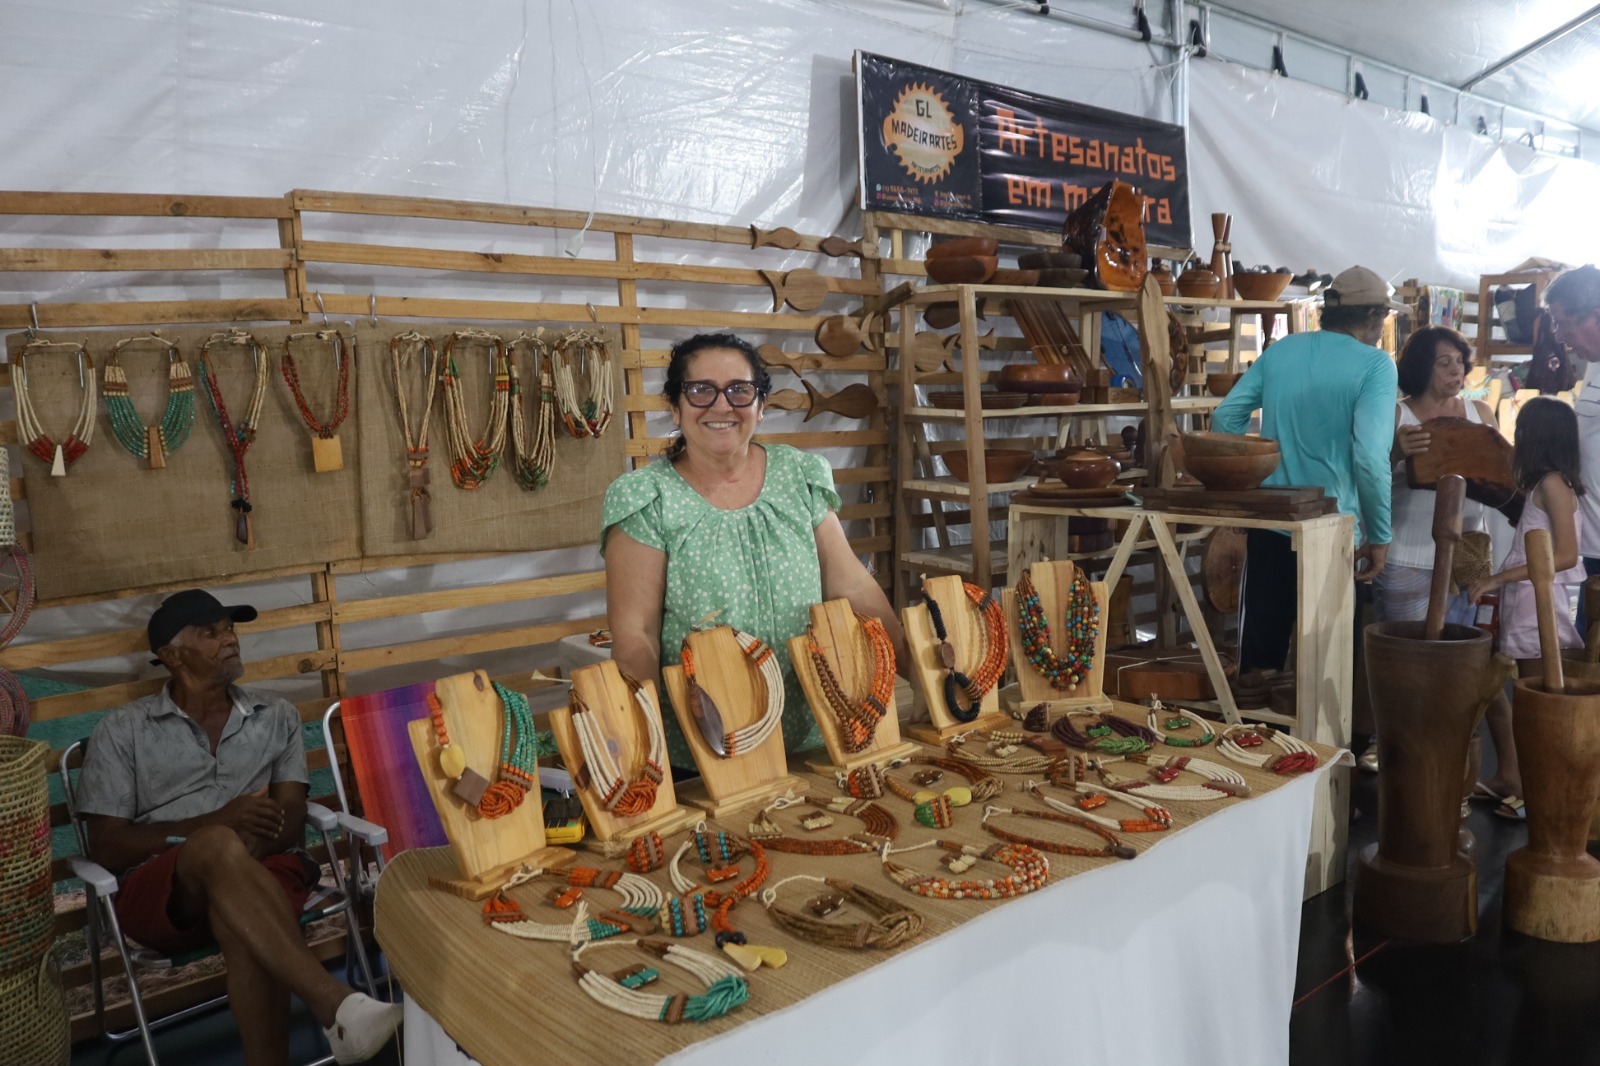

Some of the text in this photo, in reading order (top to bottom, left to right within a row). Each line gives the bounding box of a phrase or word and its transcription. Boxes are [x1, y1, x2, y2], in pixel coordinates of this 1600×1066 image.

[915, 99, 932, 119] GL
[996, 107, 1176, 182] Artesanatos
[1007, 176, 1052, 209] em
